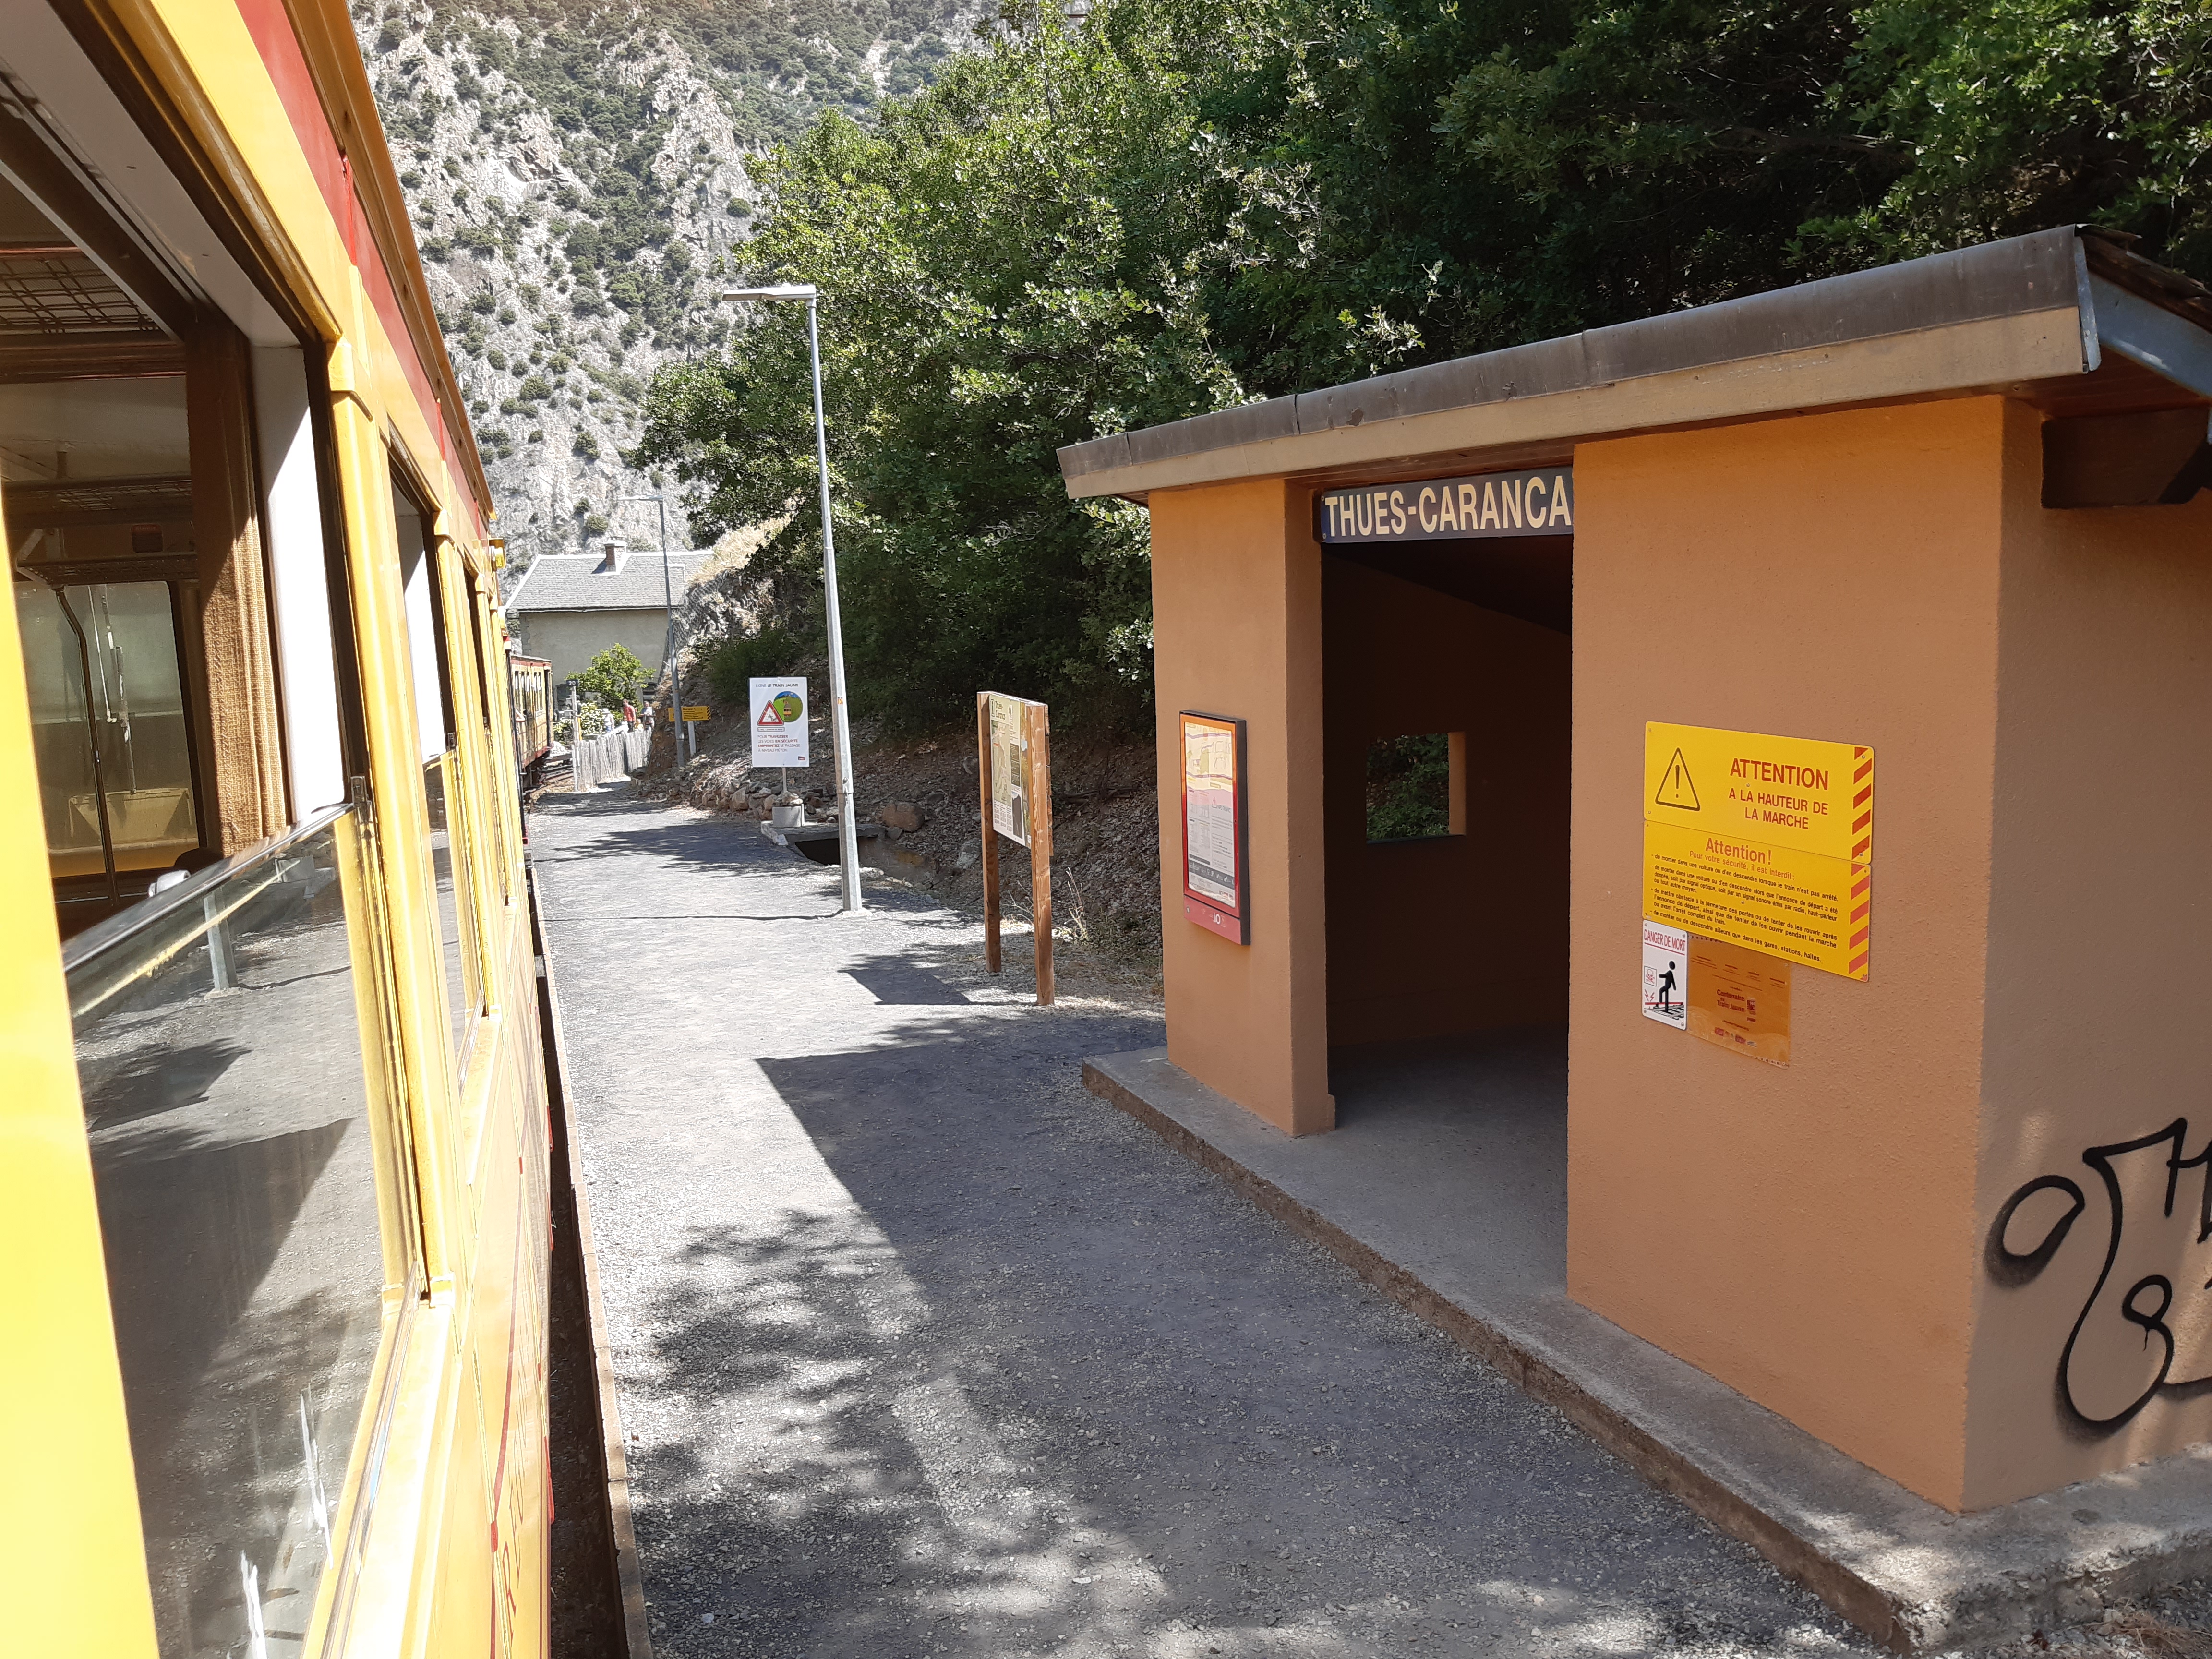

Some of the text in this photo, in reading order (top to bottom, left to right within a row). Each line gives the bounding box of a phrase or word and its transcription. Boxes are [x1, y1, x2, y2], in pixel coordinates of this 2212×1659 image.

[1324, 475, 1572, 537] THUES-CARANCA
[1730, 757, 1828, 791] ATTENTION
[1729, 788, 1828, 816] A LA HAUTEUR DE
[1745, 806, 1809, 830] LA MARCHE
[1689, 850, 1703, 859] Pour
[1705, 855, 1720, 864] votre
[1722, 858, 1749, 871] sécurité,
[1729, 882, 1752, 893] descendre
[1776, 893, 1798, 904] l'annonce
[1807, 901, 1823, 911] départ
[1733, 872, 1757, 882] descendre
[1759, 877, 1777, 887] lorsque
[1784, 883, 1795, 891] train
[1796, 887, 1809, 895] n'est
[1654, 894, 1675, 904] l'annonce
[1684, 902, 1701, 913] départ,
[1734, 915, 1749, 925] tenter
[1785, 930, 1807, 940] pendant
[1815, 938, 1837, 948] marche
[1676, 893, 1695, 903] obstacle
[1705, 901, 1727, 911] fermeture
[1739, 910, 1754, 918] portes
[1771, 918, 1786, 926] tenter
[1804, 927, 1821, 936] rouvrir
[1822, 932, 1838, 940] après
[1687, 911, 1706, 920] complet
[1714, 917, 1726, 925] train.
[1793, 906, 1806, 915] radio,
[1644, 929, 1685, 951] DANGER DE MORT
[1660, 912, 1675, 920] monter
[1690, 920, 1713, 931] descendre
[1764, 941, 1779, 950] gares,
[1804, 951, 1821, 962] haltes.
